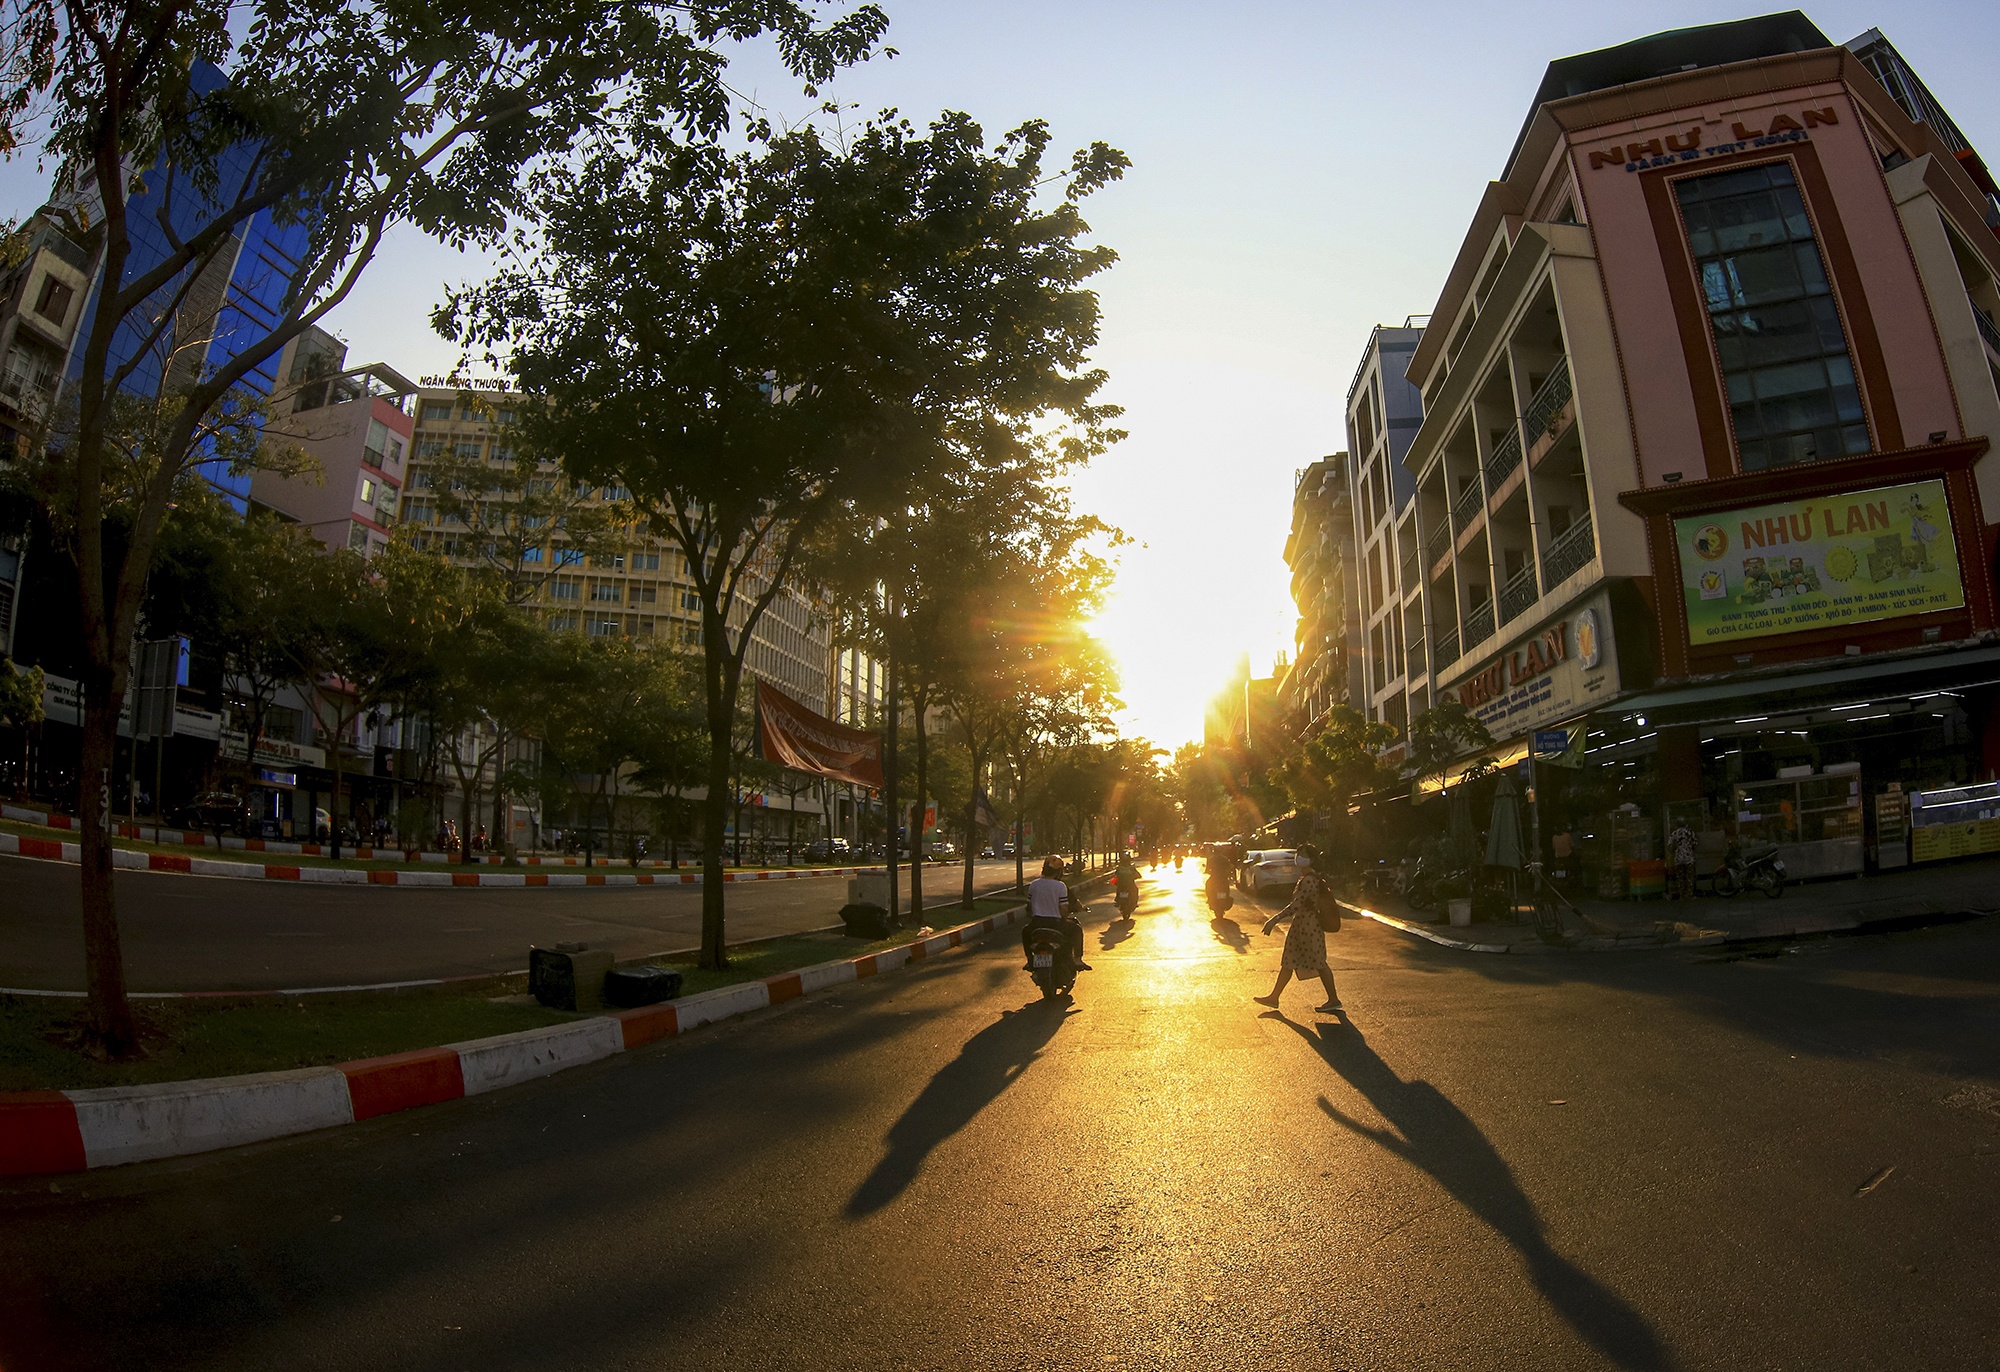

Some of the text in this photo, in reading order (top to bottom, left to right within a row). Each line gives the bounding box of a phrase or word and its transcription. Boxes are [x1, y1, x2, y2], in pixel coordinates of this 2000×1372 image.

[1588, 106, 1839, 170] NHƯ LAN
[419, 373, 445, 387] NGÂN
[1740, 500, 1890, 550] NHƯ LAN
[1770, 606, 1785, 615] THU
[1889, 587, 1905, 598] SINH
[1858, 602, 1887, 615] JAMBON
[1509, 621, 1567, 686] LAN
